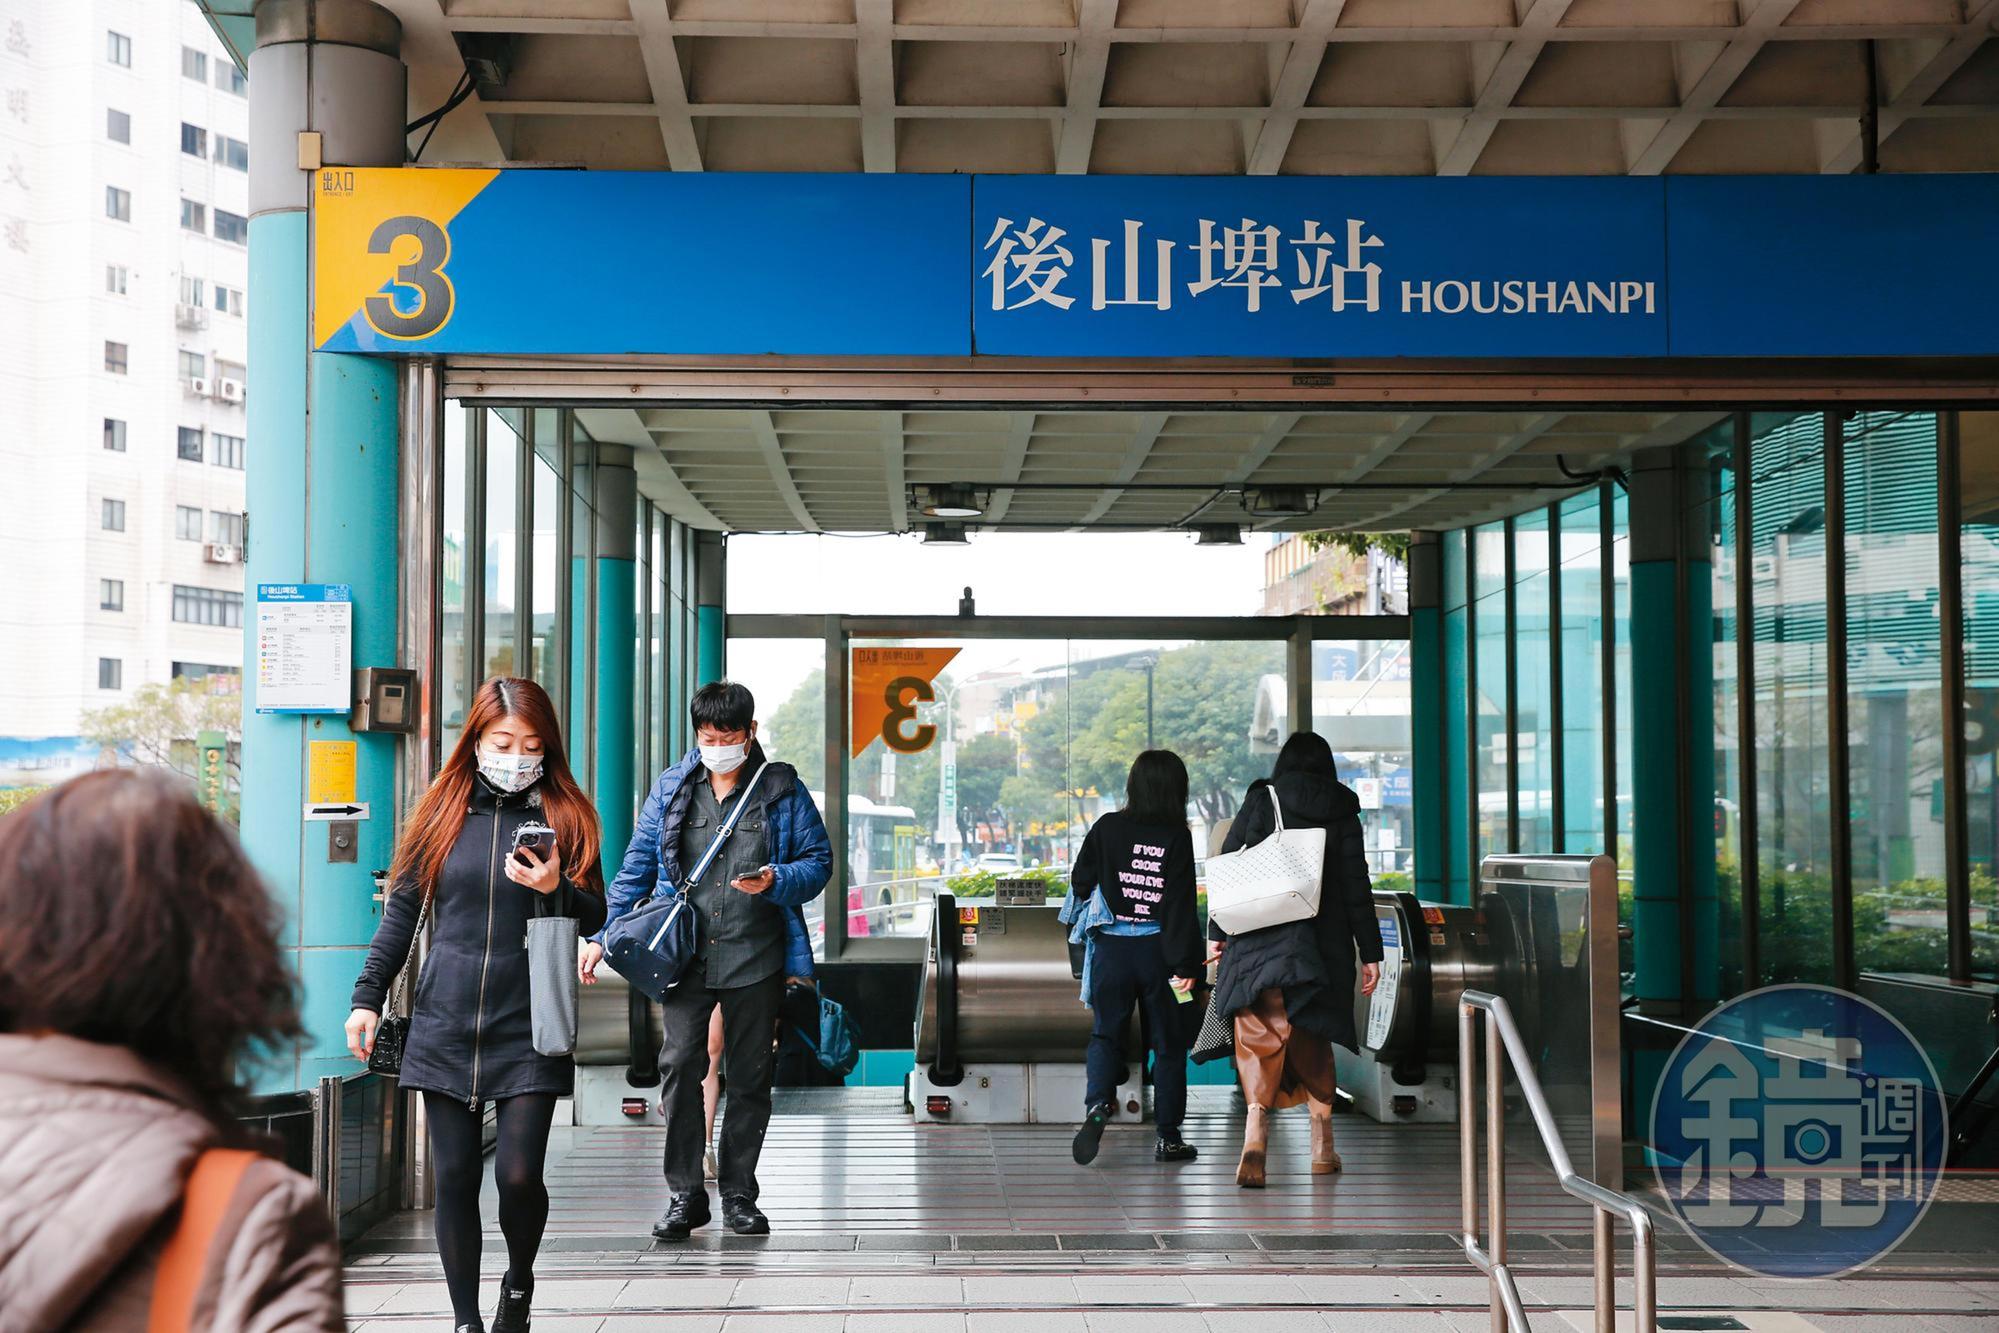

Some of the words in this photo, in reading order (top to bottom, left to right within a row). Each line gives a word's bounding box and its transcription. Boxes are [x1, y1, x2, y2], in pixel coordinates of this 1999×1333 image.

[322, 171, 355, 192] 出入口
[981, 217, 1384, 313] 後山埤站
[365, 216, 453, 338] 3
[1400, 280, 1656, 315] HOUSHANPI
[1143, 845, 1165, 857] YOU
[1119, 872, 1145, 885] YOUR
[1122, 887, 1142, 899] YOU
[981, 1076, 988, 1088] 8
